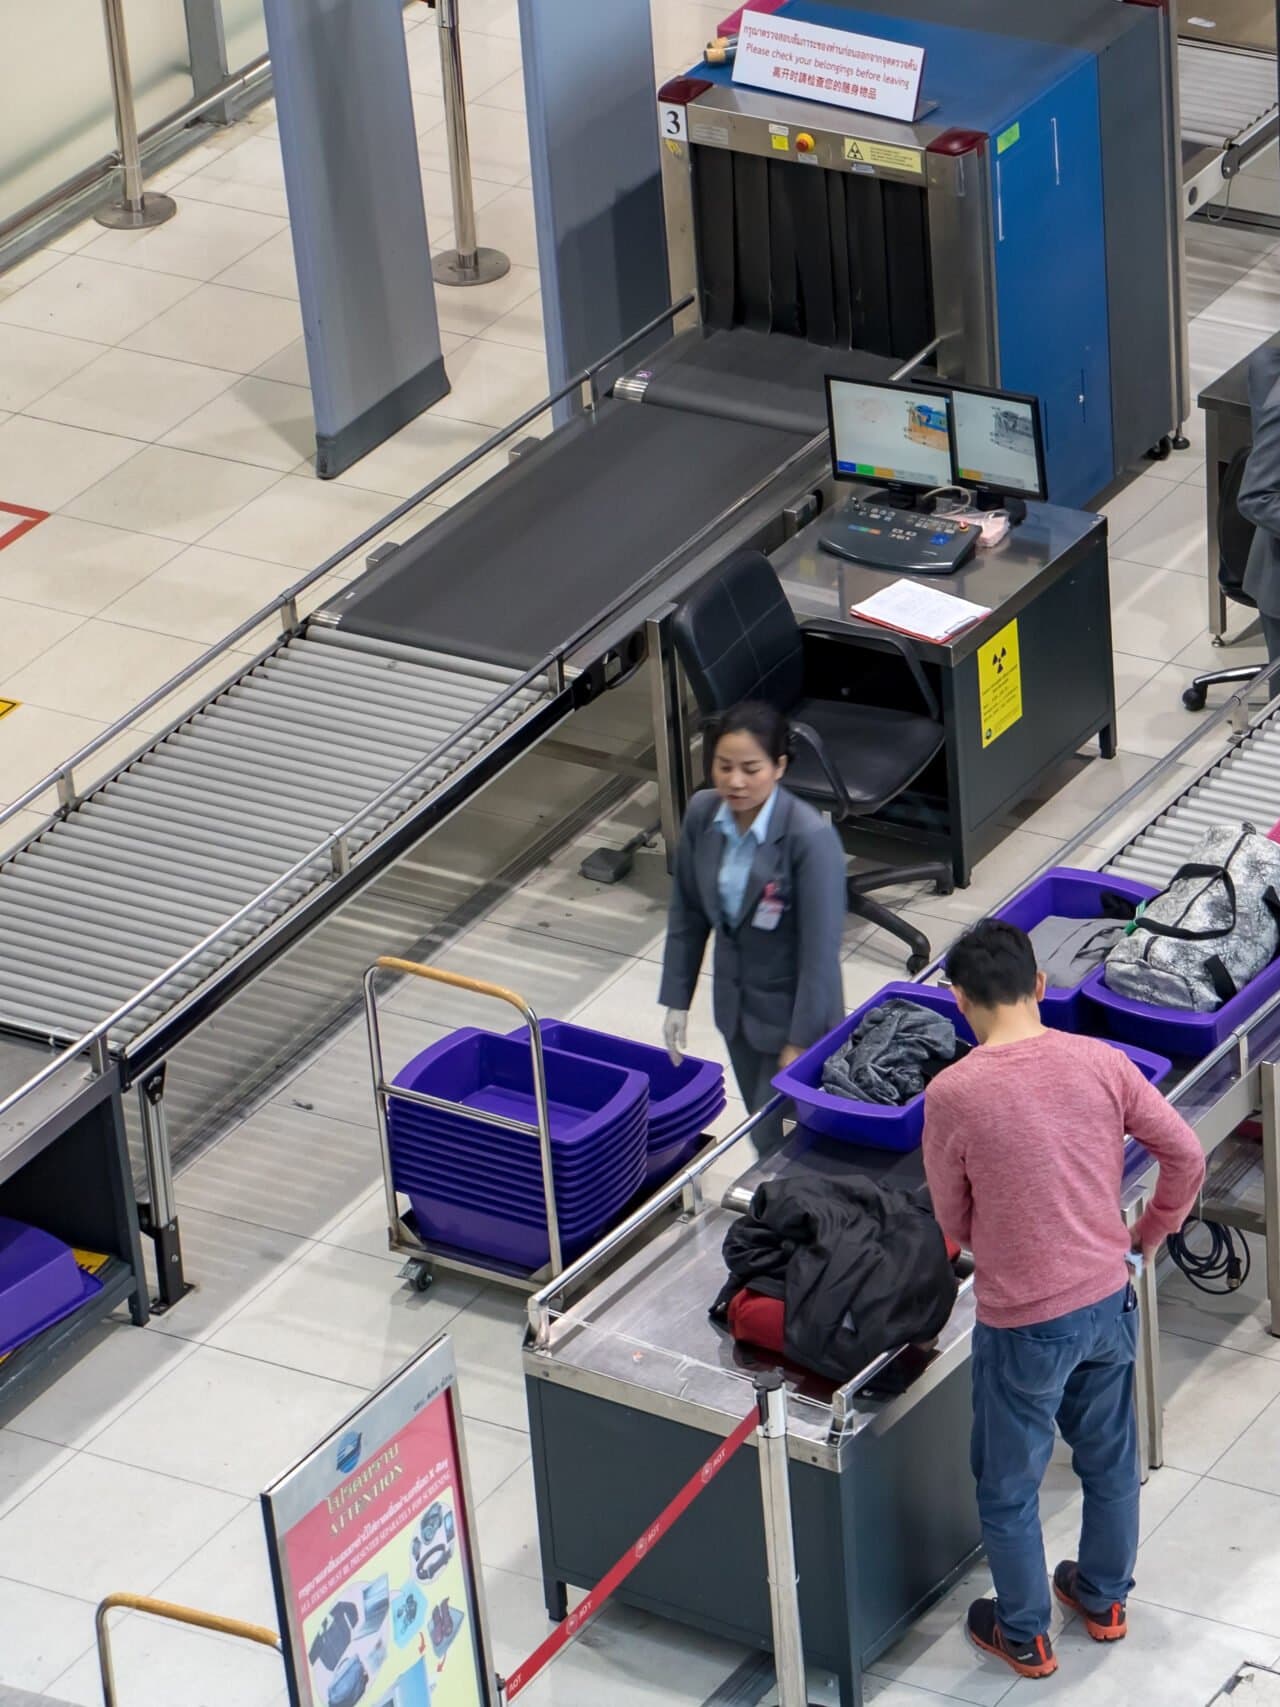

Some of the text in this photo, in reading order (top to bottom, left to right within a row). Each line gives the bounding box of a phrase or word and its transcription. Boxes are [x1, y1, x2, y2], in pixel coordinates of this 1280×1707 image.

[746, 42, 910, 90] Please check your belongings before leaving
[666, 110, 681, 135] 3
[713, 1448, 727, 1467] AOT
[329, 1464, 403, 1536] ATTENTION
[508, 1673, 522, 1693] AOT
